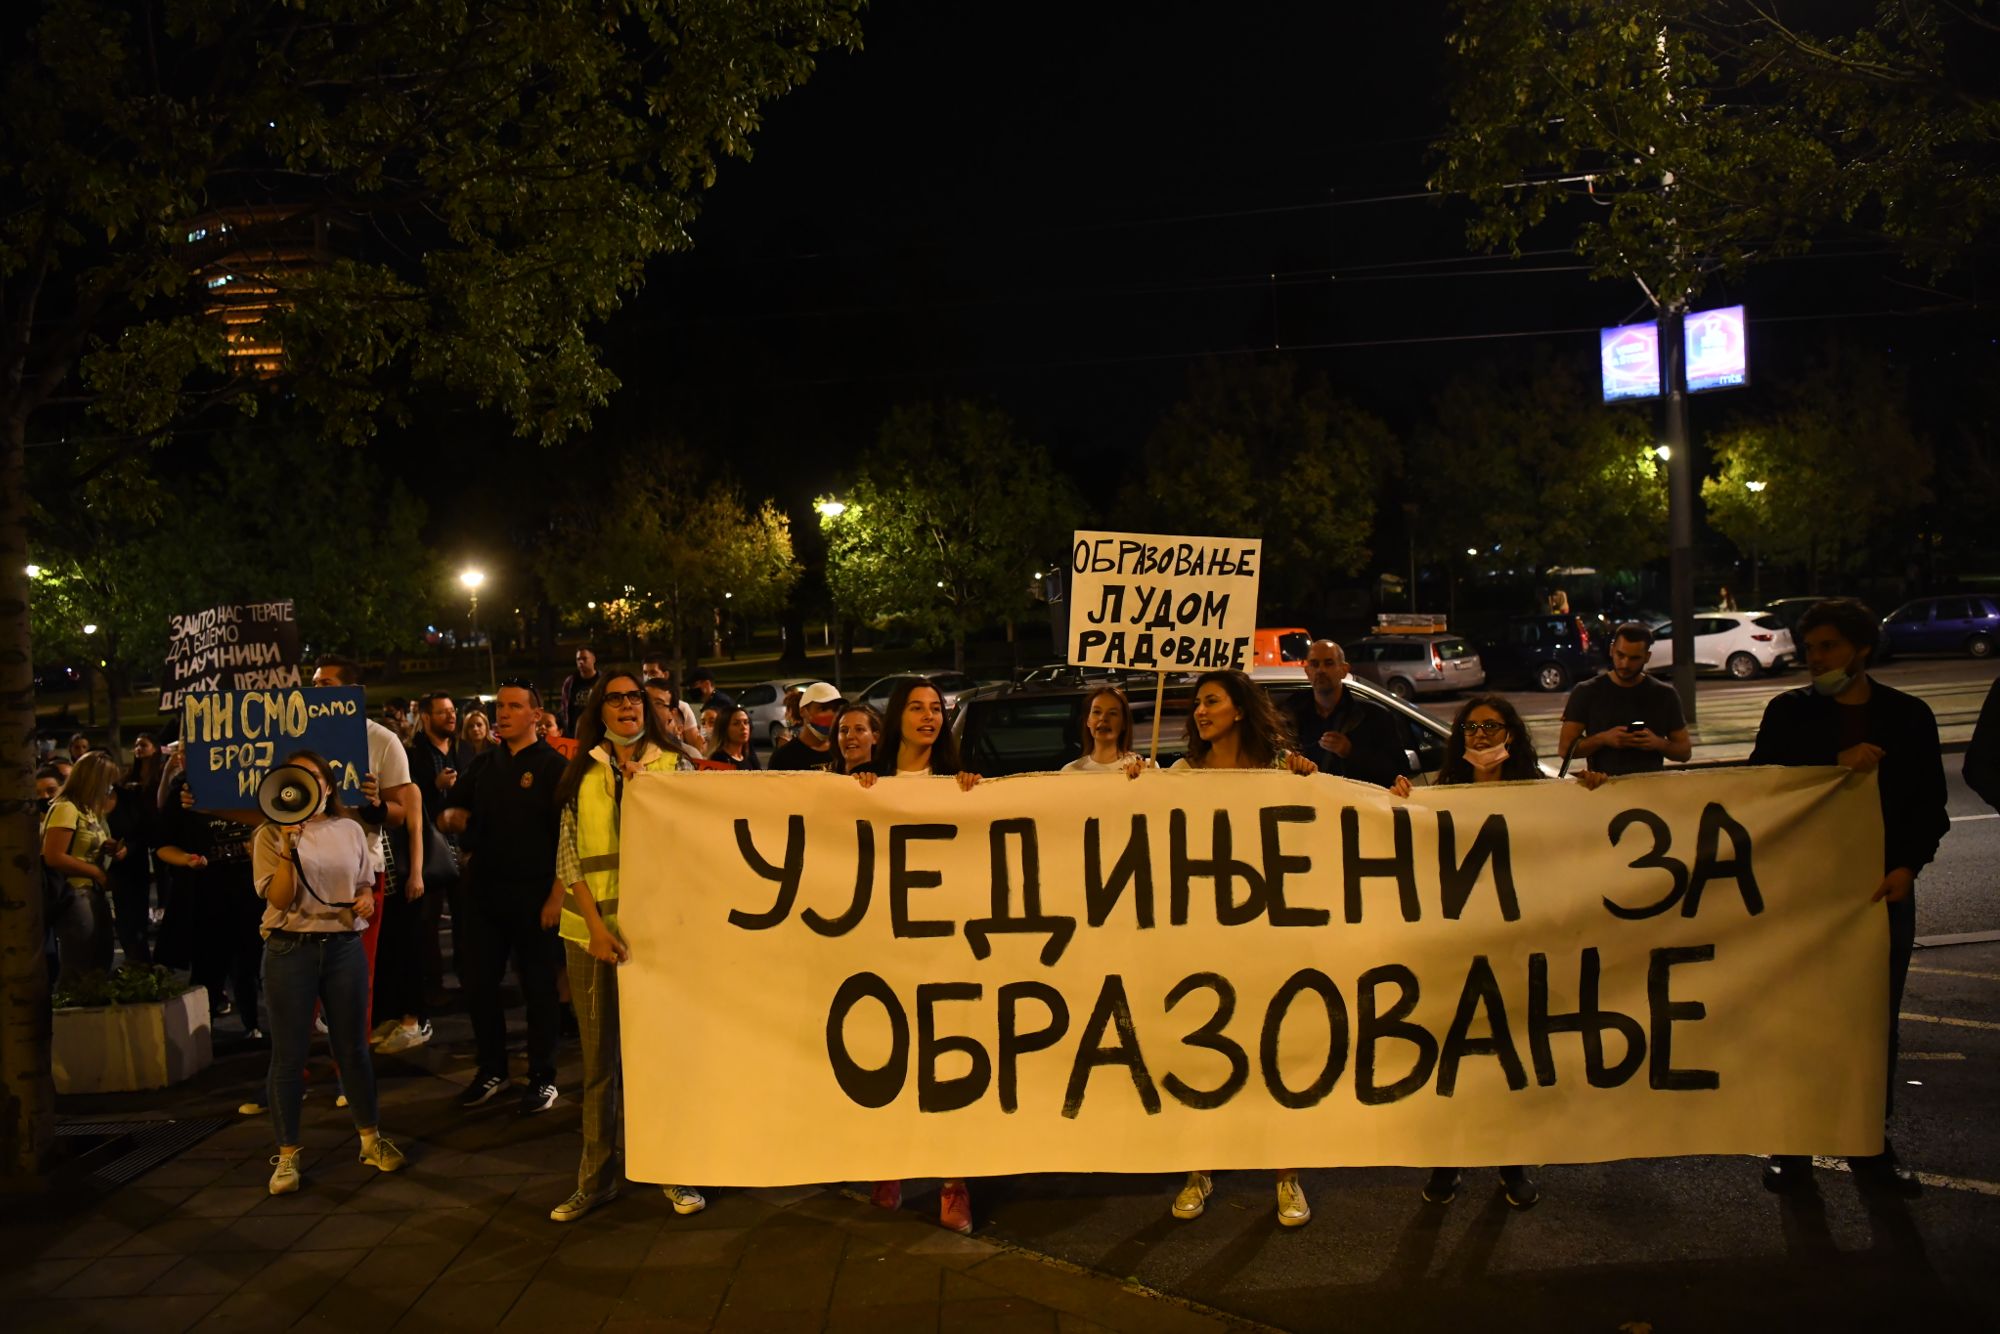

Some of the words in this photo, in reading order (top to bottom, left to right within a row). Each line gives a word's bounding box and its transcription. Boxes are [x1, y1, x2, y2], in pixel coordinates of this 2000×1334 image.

[1073, 539, 1256, 577] ОБРАЗОВАЊЕ
[216, 604, 244, 624] НАС
[245, 602, 295, 622] ТЕРАТЕ
[1087, 584, 1230, 631] ЛУДОМ
[164, 637, 191, 665] ДА
[174, 641, 282, 680] НАУЧНИЦИ
[1077, 630, 1250, 671] РАДОВАЊЕ
[240, 689, 308, 739] СМО
[308, 699, 358, 718] САМО
[726, 805, 1521, 967] УЈЕДИЊЕНИ
[1601, 801, 1764, 921] ЗА
[825, 944, 1720, 1120] ОБРАЗОВАЊЕ
